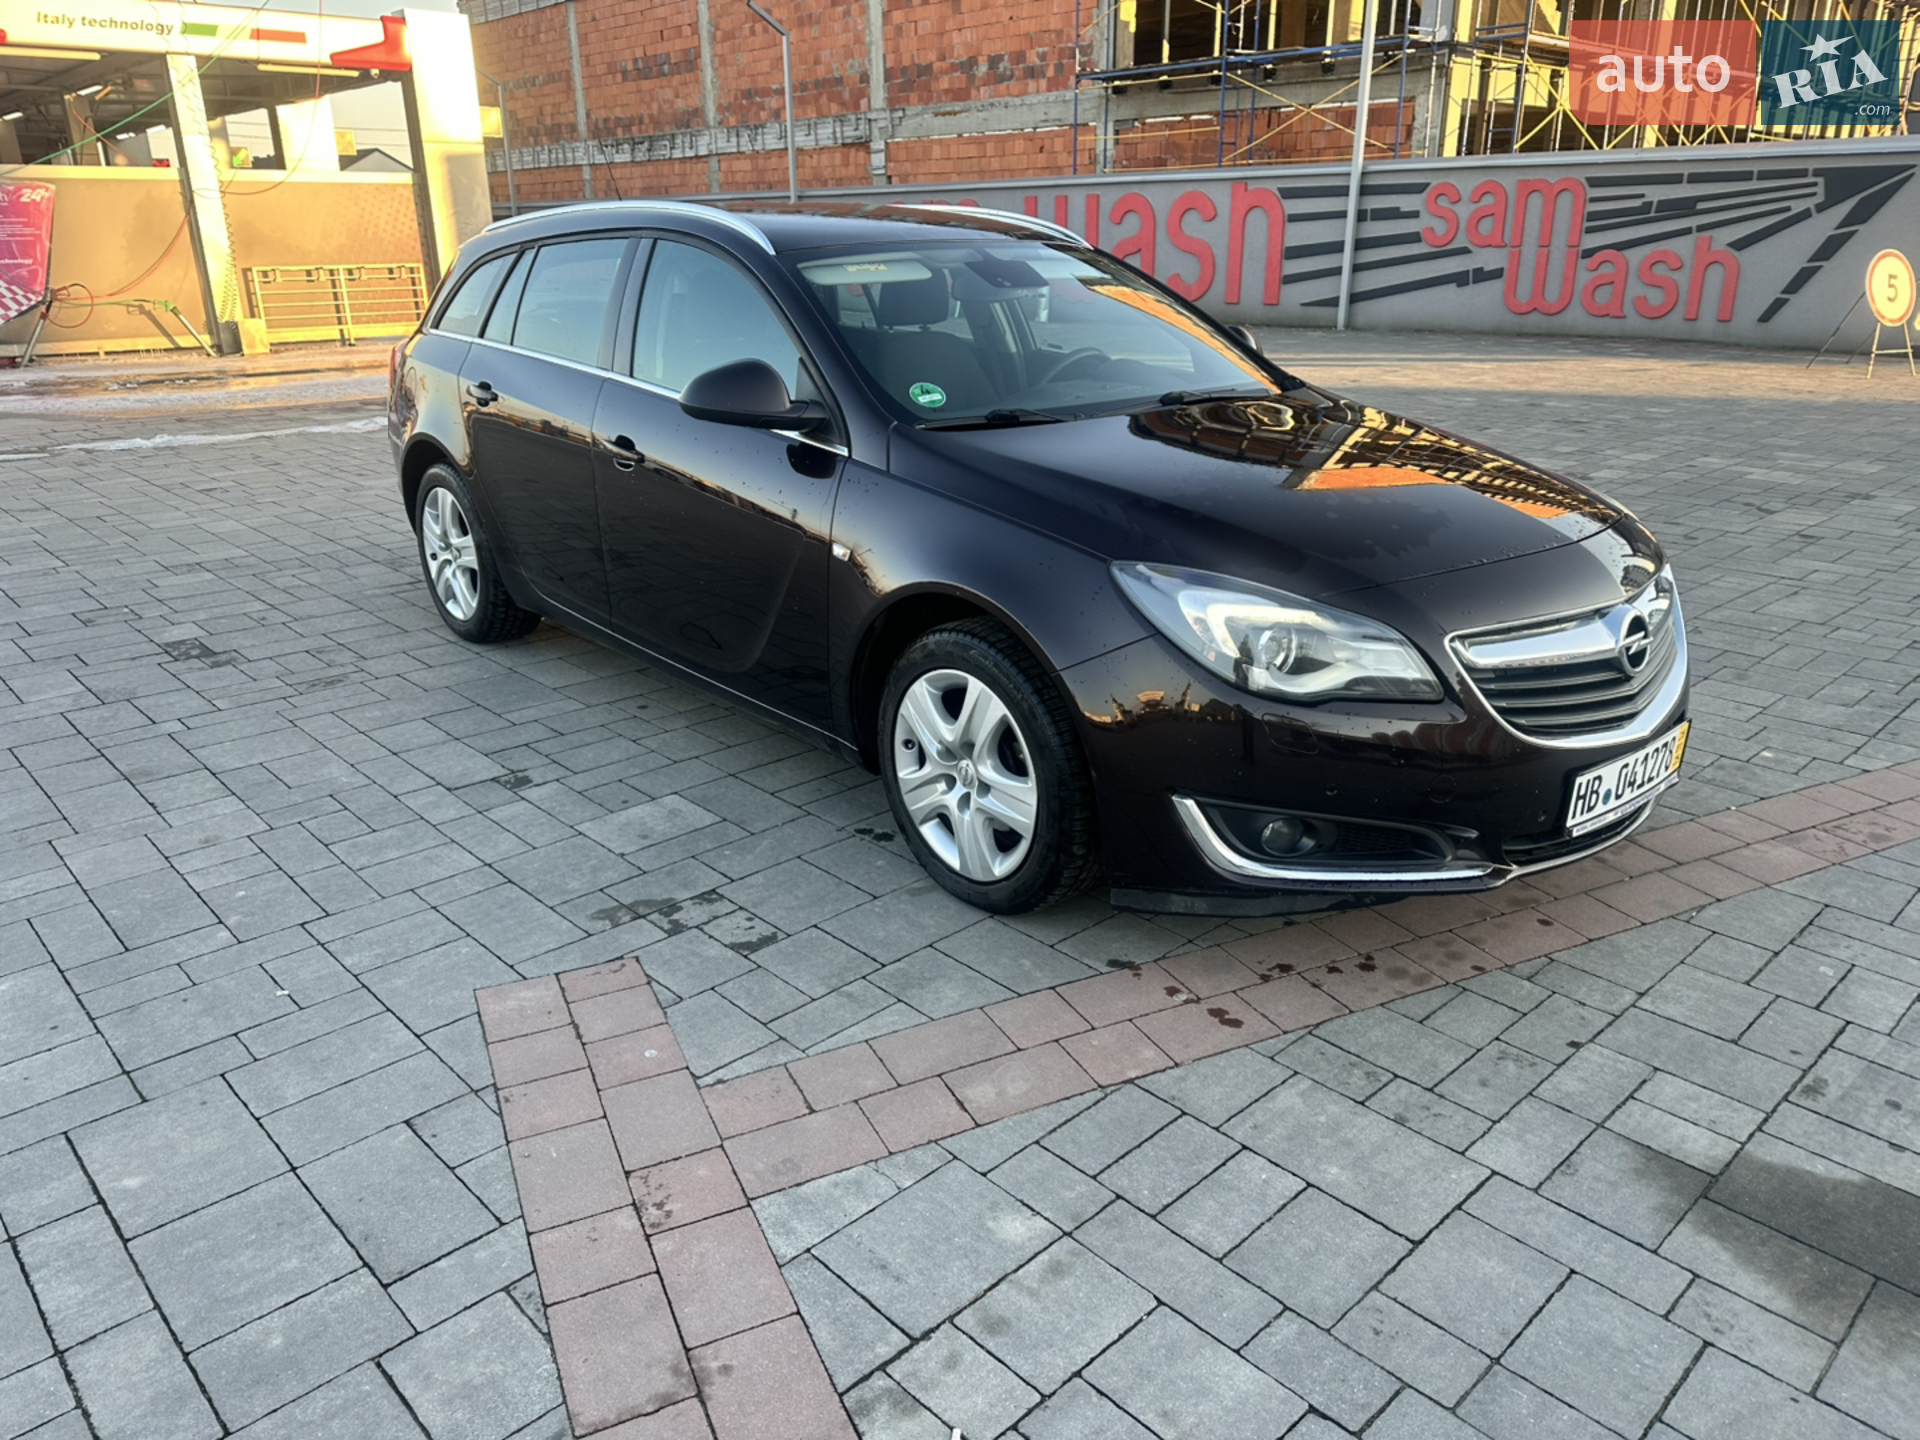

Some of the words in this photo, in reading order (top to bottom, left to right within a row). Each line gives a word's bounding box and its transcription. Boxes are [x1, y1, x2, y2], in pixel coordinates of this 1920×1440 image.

[36, 11, 75, 28] Italy
[81, 16, 174, 35] technology
[1421, 176, 1587, 248] sam
[1887, 273, 1899, 303] 5
[1571, 774, 1603, 820] HB
